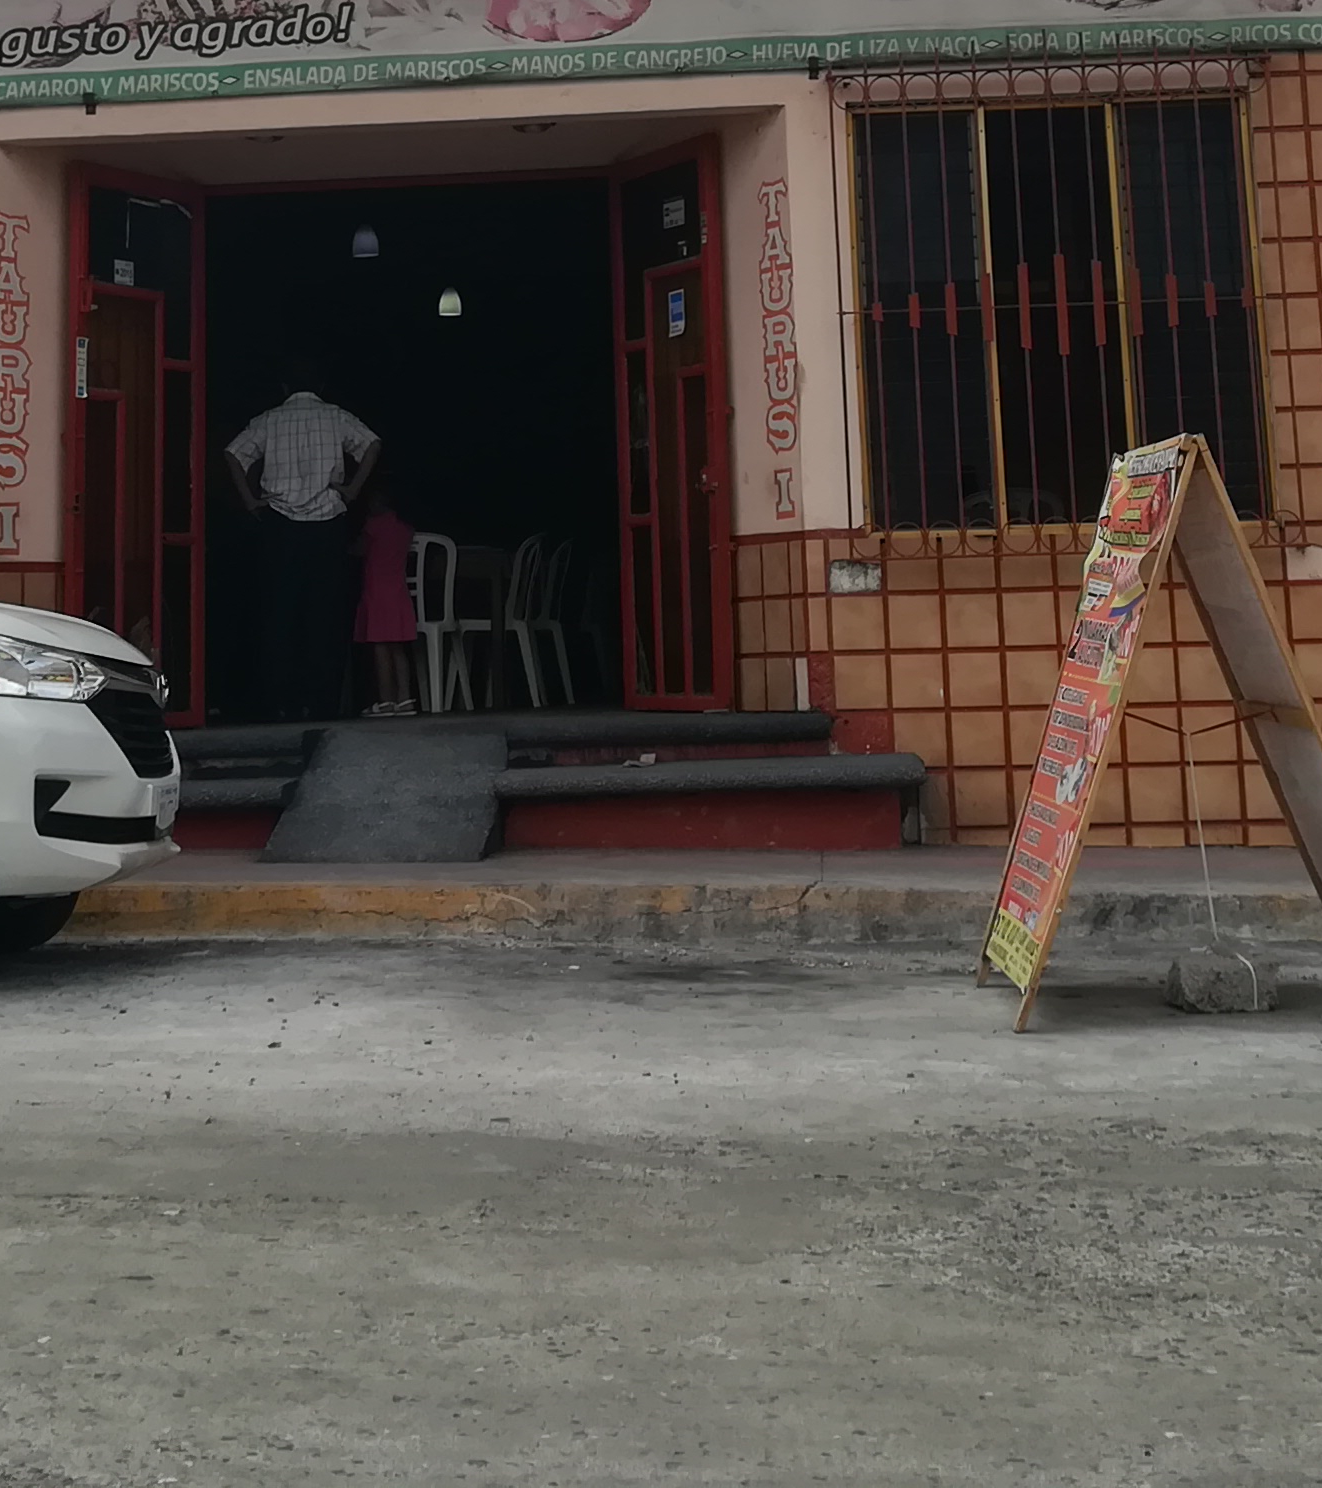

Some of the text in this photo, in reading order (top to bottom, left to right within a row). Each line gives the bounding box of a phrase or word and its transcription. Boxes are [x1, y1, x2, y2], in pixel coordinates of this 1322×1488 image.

[99, 77, 115, 97] Y
[117, 70, 219, 96] MARISCOS
[243, 64, 347, 90] ENSALADA
[352, 62, 378, 84] DE
[385, 55, 487, 81] MARISCOS
[510, 51, 586, 77] MANOS
[591, 49, 617, 71] DE
[623, 45, 728, 71] CANGREJO
[824, 40, 853, 62] DE
[905, 35, 919, 55] Y
[1008, 30, 1060, 53] SOPA
[1066, 29, 1092, 51] DE
[1098, 25, 1207, 50] MARISCOS
[1230, 22, 1292, 44] RICOS
[134, 19, 171, 60] y
[171, 1, 355, 59] agrado!
